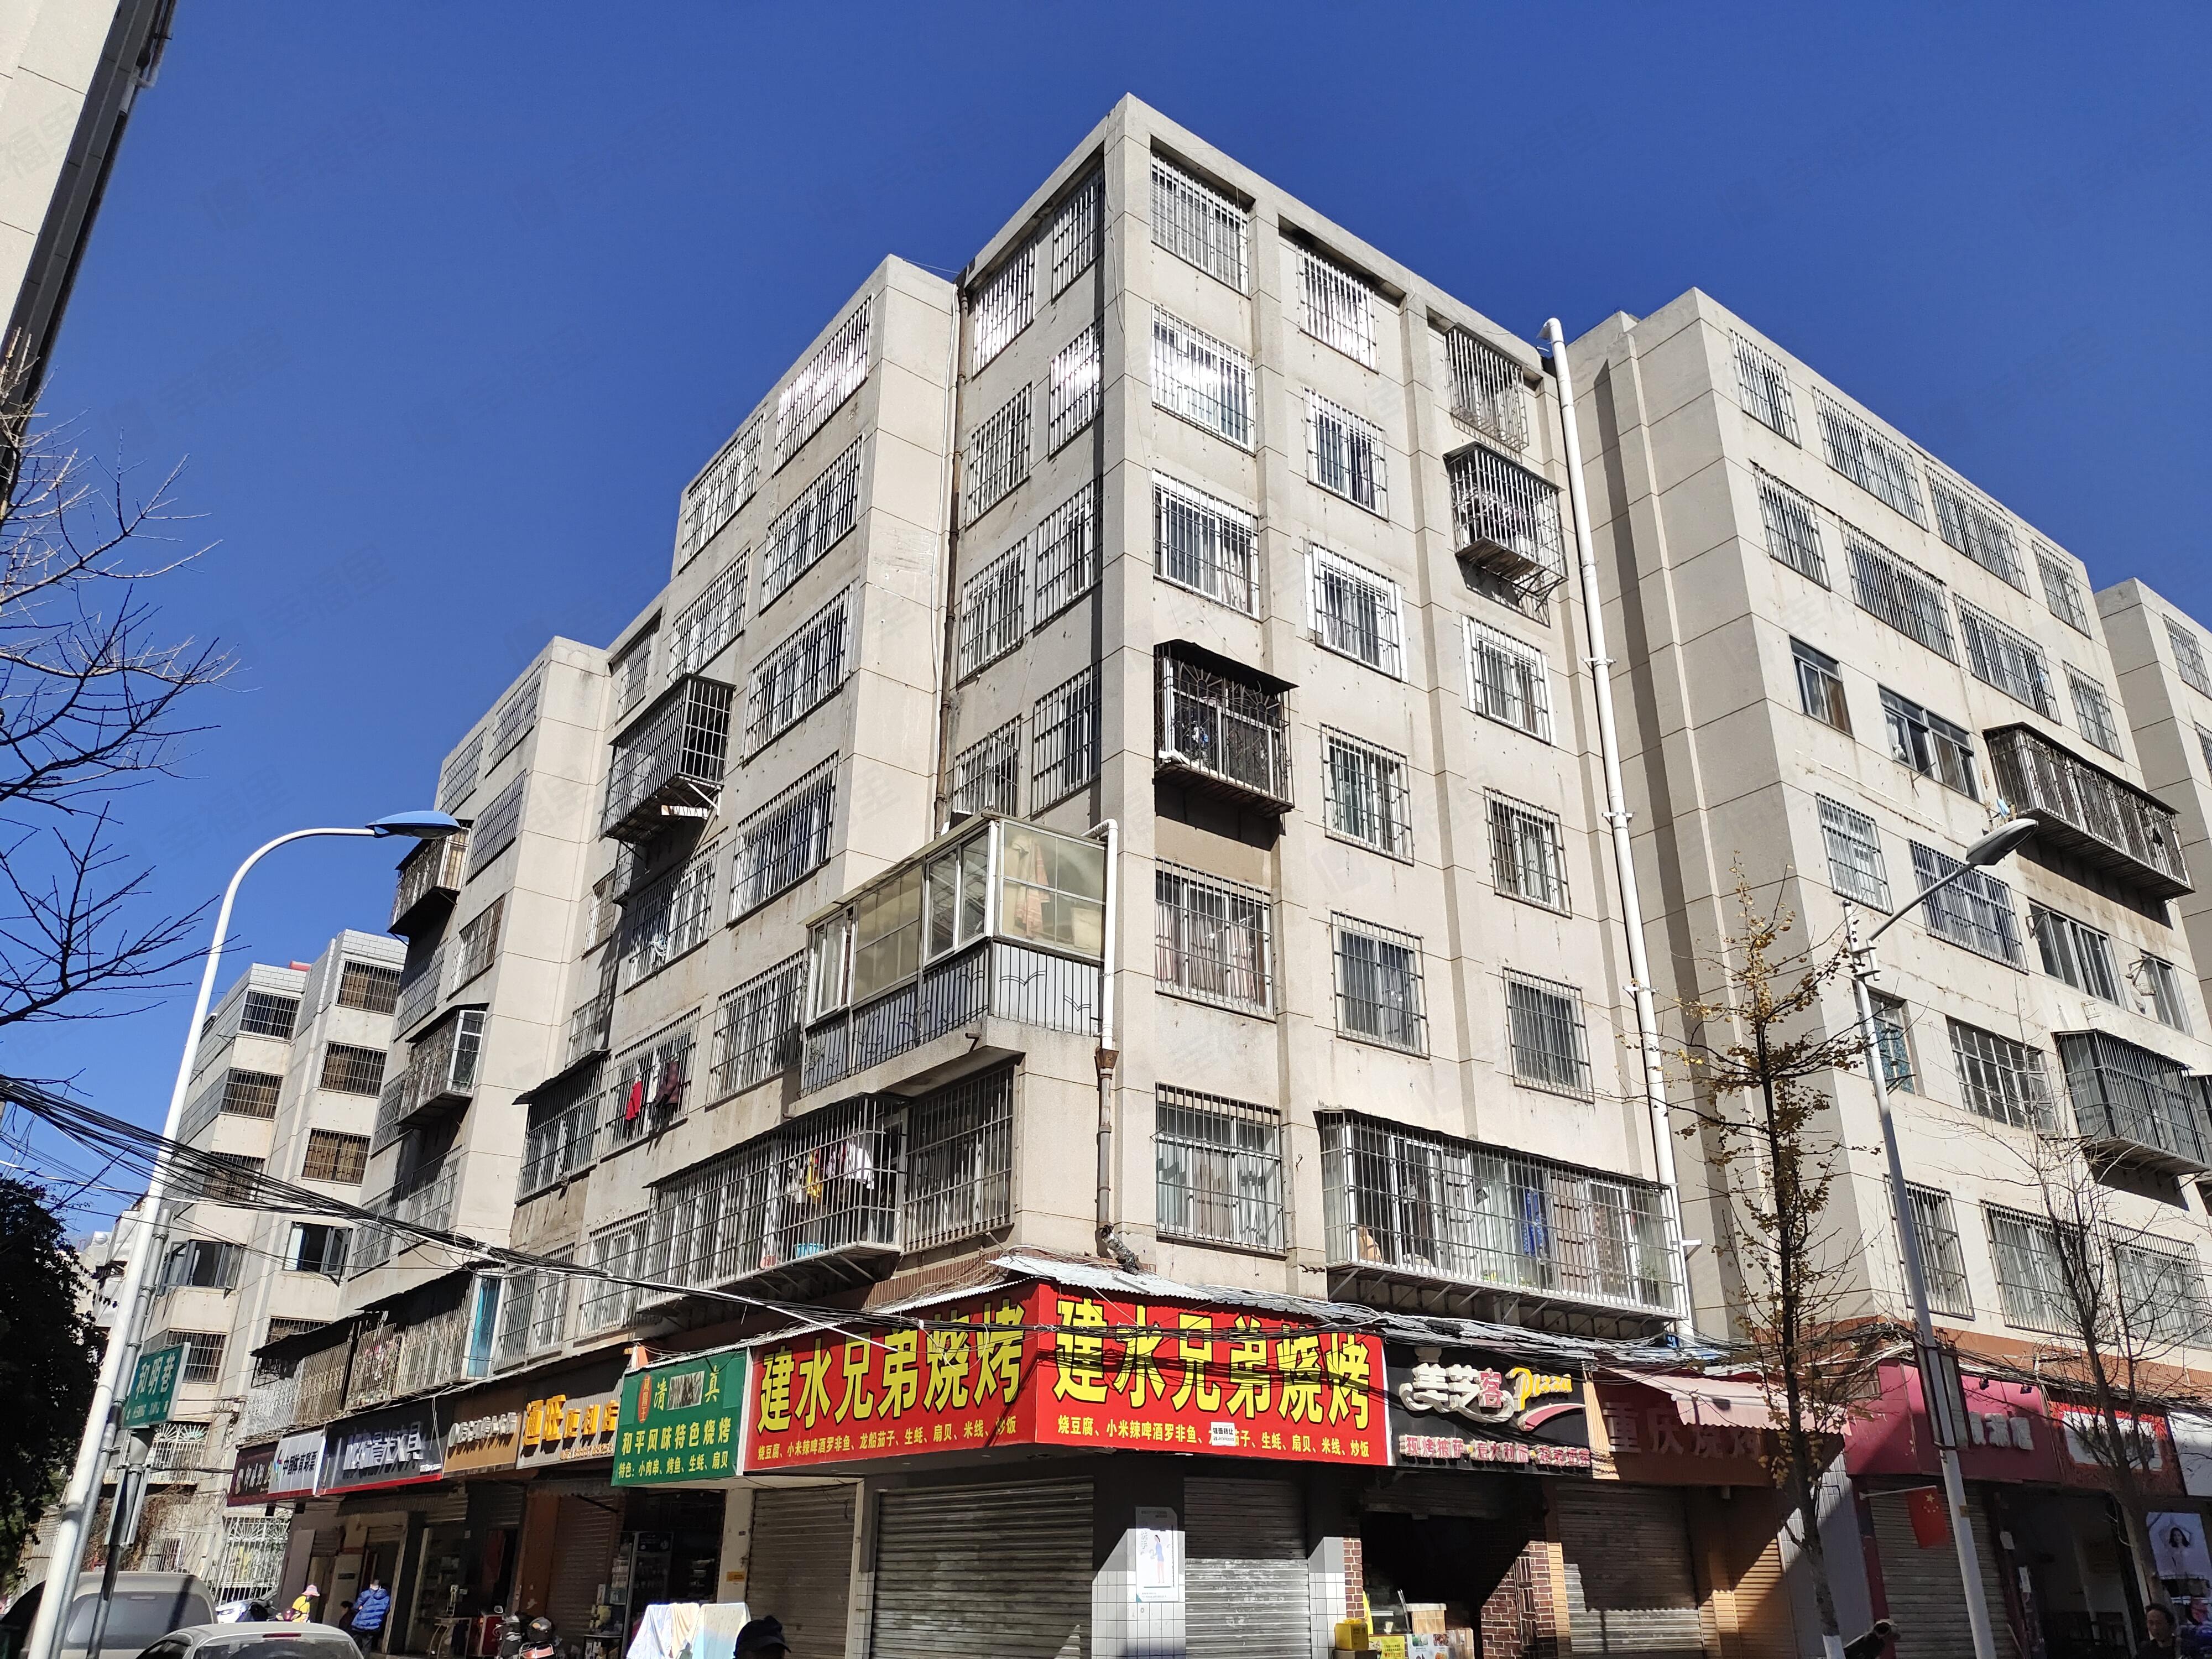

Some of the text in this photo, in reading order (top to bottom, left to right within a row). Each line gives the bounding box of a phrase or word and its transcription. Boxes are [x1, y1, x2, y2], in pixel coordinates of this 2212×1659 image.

[654, 1365, 720, 1411] 清 真
[758, 1298, 1025, 1433] 建水兄弟烧烤
[1054, 1298, 1370, 1430] 建水兄弟烧烤
[523, 1394, 620, 1446] 通旺便利店
[622, 1417, 732, 1456] 和平风味特色烧烤
